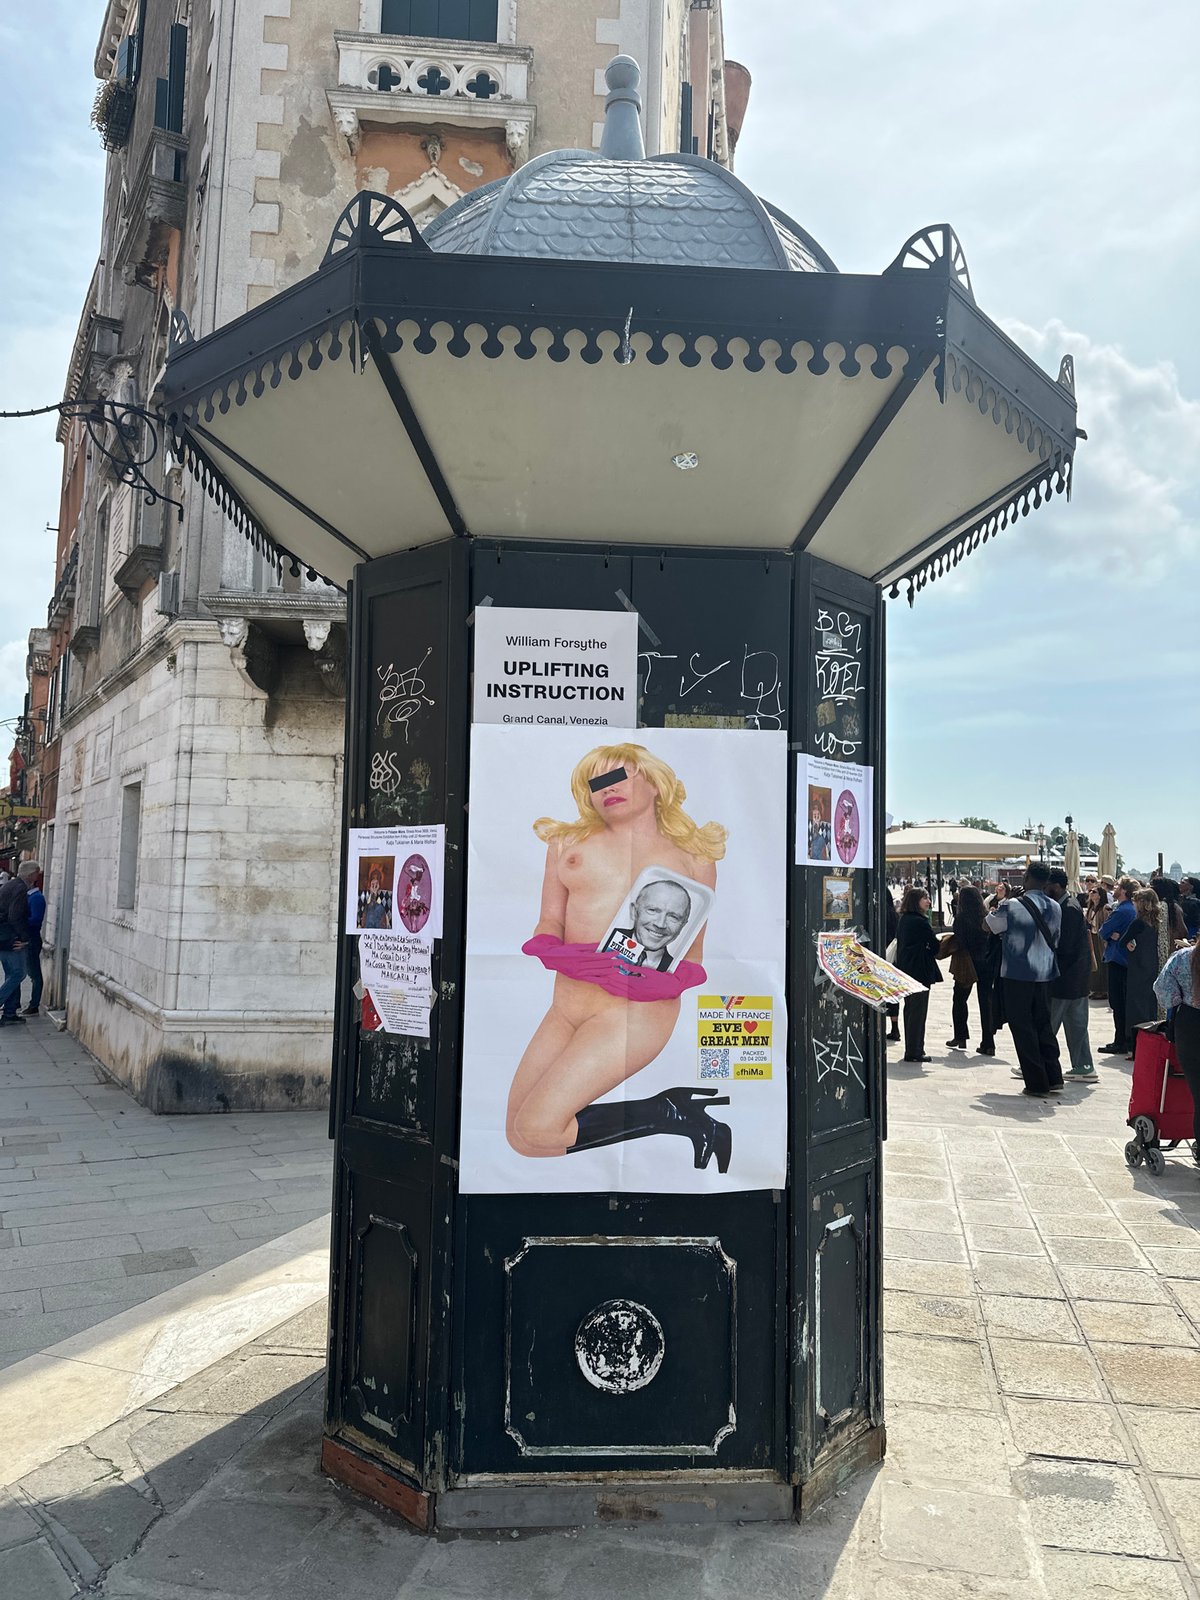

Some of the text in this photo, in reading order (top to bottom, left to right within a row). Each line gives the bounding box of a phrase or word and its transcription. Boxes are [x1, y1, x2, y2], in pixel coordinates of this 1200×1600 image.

[505, 635, 608, 651] William Forsythe
[503, 660, 609, 679] UPLIFTING
[486, 683, 625, 702] INSTRUCTION
[502, 714, 609, 726] Grand Canal, Venezia
[619, 935, 627, 946] I
[610, 941, 636, 960] PINAULT
[712, 1023, 742, 1032] EVE
[700, 1036, 770, 1046] GREAT MEN
